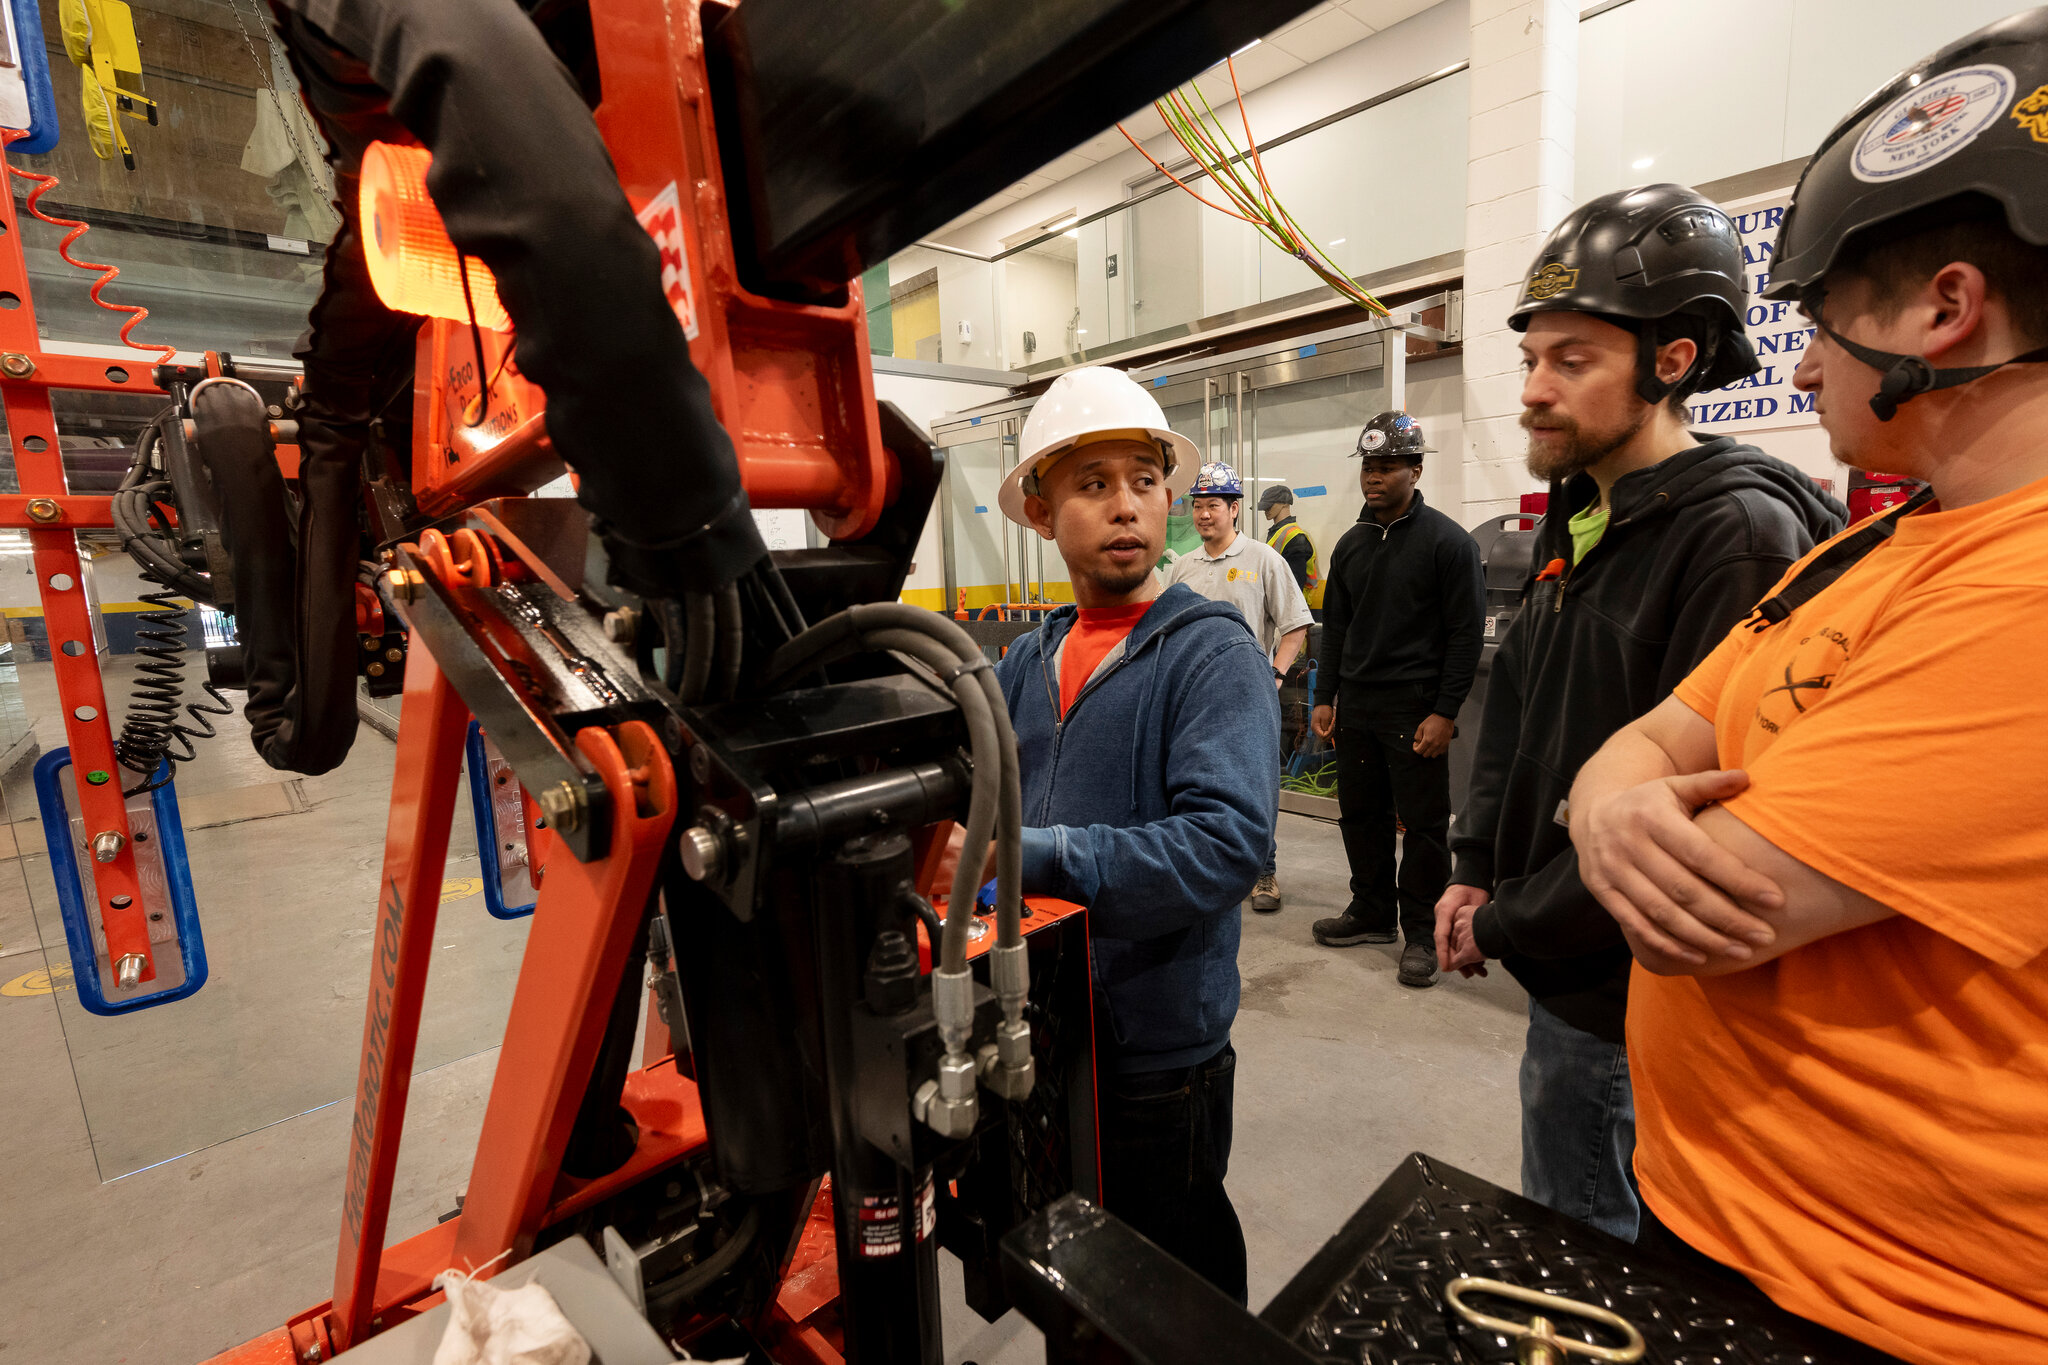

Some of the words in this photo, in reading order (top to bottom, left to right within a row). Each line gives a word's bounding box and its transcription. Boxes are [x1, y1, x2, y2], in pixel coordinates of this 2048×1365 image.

[1894, 85, 1957, 119] GLAZIERS
[1890, 149, 1916, 162] NEW
[1921, 127, 1960, 152] YORK
[1746, 300, 1791, 327] OF
[865, 1243, 901, 1256] ANGER
